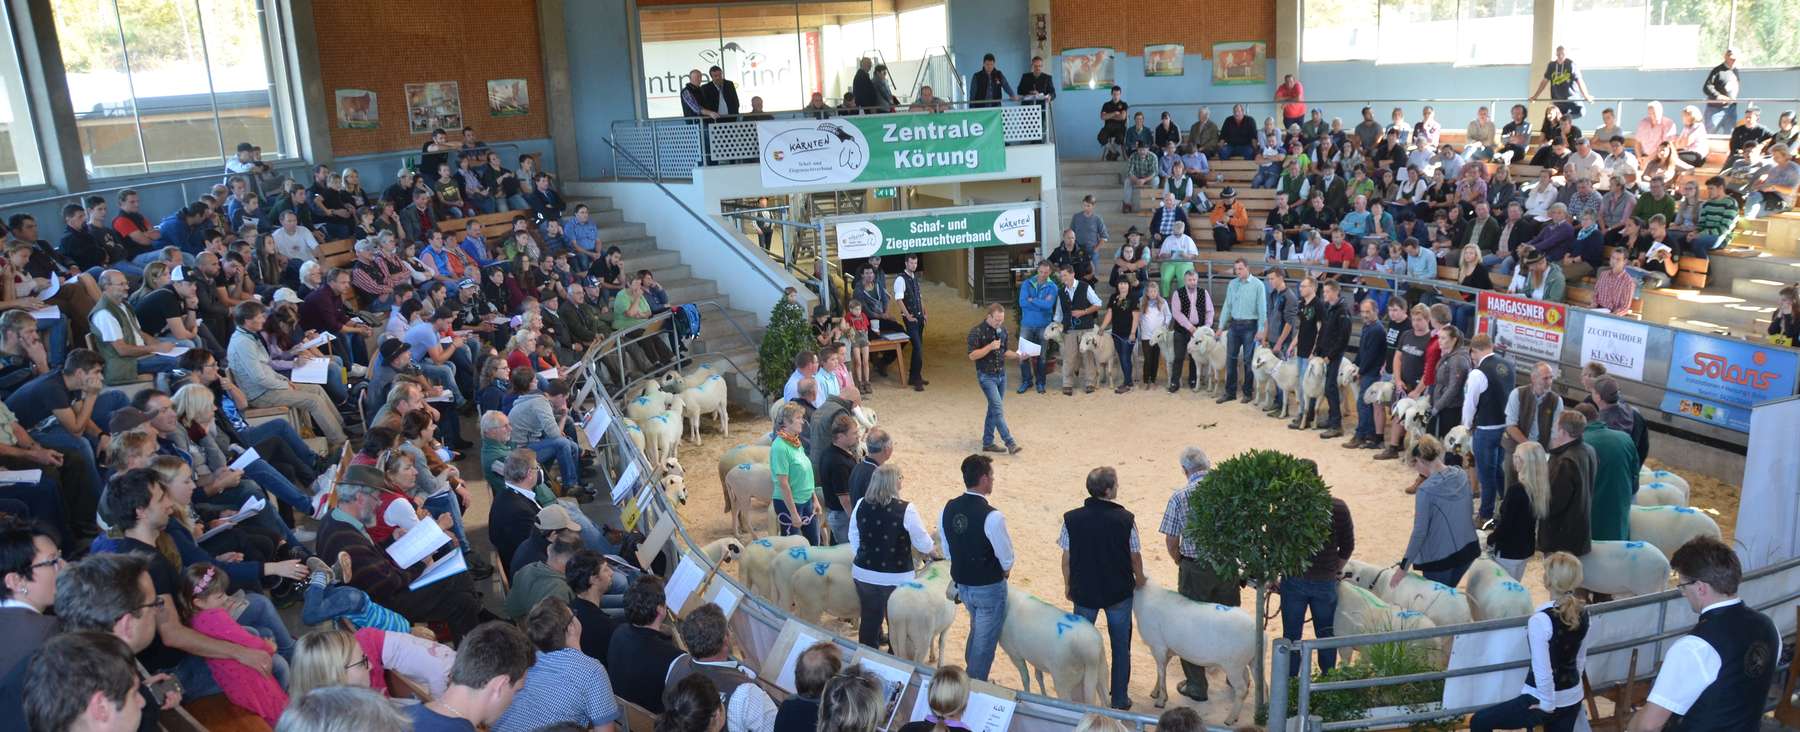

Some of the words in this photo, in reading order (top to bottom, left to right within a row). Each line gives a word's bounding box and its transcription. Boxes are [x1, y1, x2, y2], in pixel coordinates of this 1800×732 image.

[882, 119, 985, 143] Zentrale
[893, 148, 979, 169] Körung
[910, 221, 945, 234] Schaf-
[948, 218, 967, 230] und
[886, 229, 992, 250] Ziegenzuchtverband
[1487, 296, 1545, 320] HARGASSNER
[1587, 327, 1643, 344] ZUCHTWIDDER
